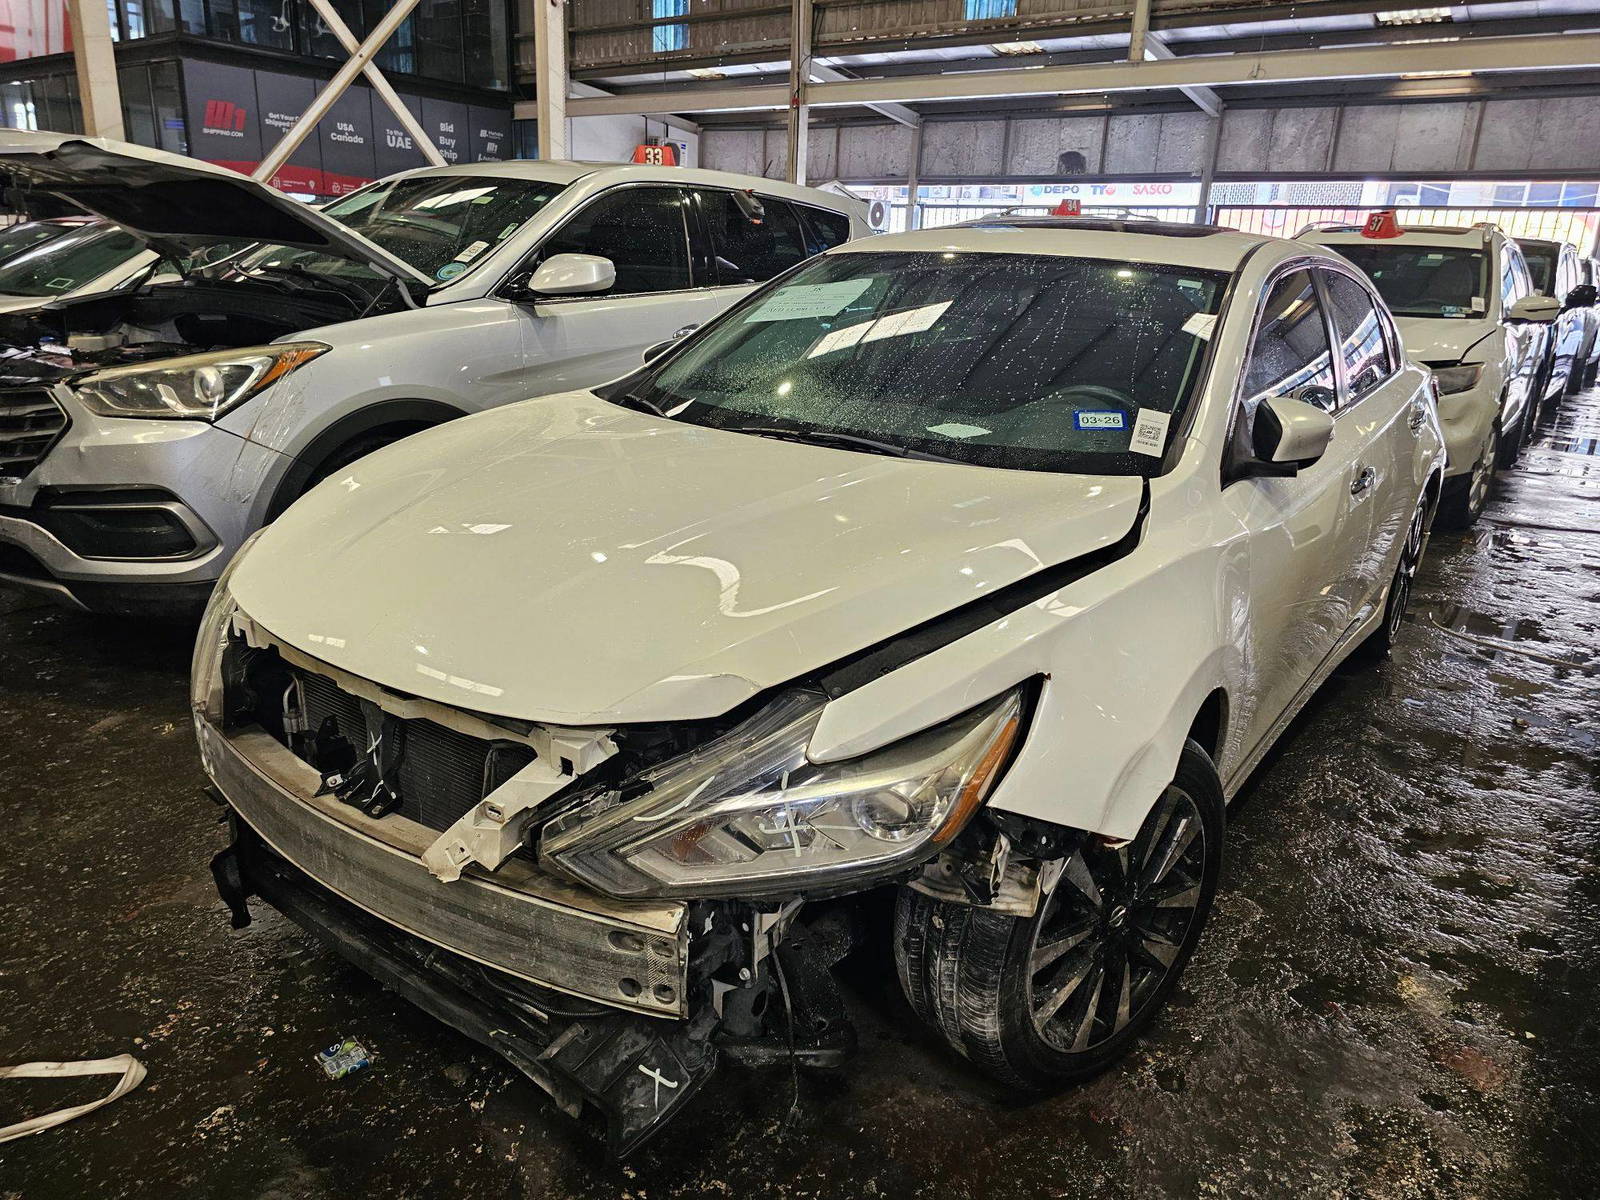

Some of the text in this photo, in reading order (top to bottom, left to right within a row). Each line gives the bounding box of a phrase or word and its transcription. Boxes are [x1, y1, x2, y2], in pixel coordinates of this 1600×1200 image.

[336, 122, 354, 133] USA
[394, 129, 403, 137] the
[439, 122, 454, 133] Bid
[330, 132, 364, 144] Canada
[386, 135, 412, 150] UAE
[439, 136, 456, 147] Buy
[439, 149, 458, 162] Ship
[645, 147, 663, 166] 33
[1043, 185, 1080, 194] DEPO
[1132, 184, 1173, 195] SASCO
[1066, 199, 1078, 212] 34
[1369, 216, 1384, 232] 37
